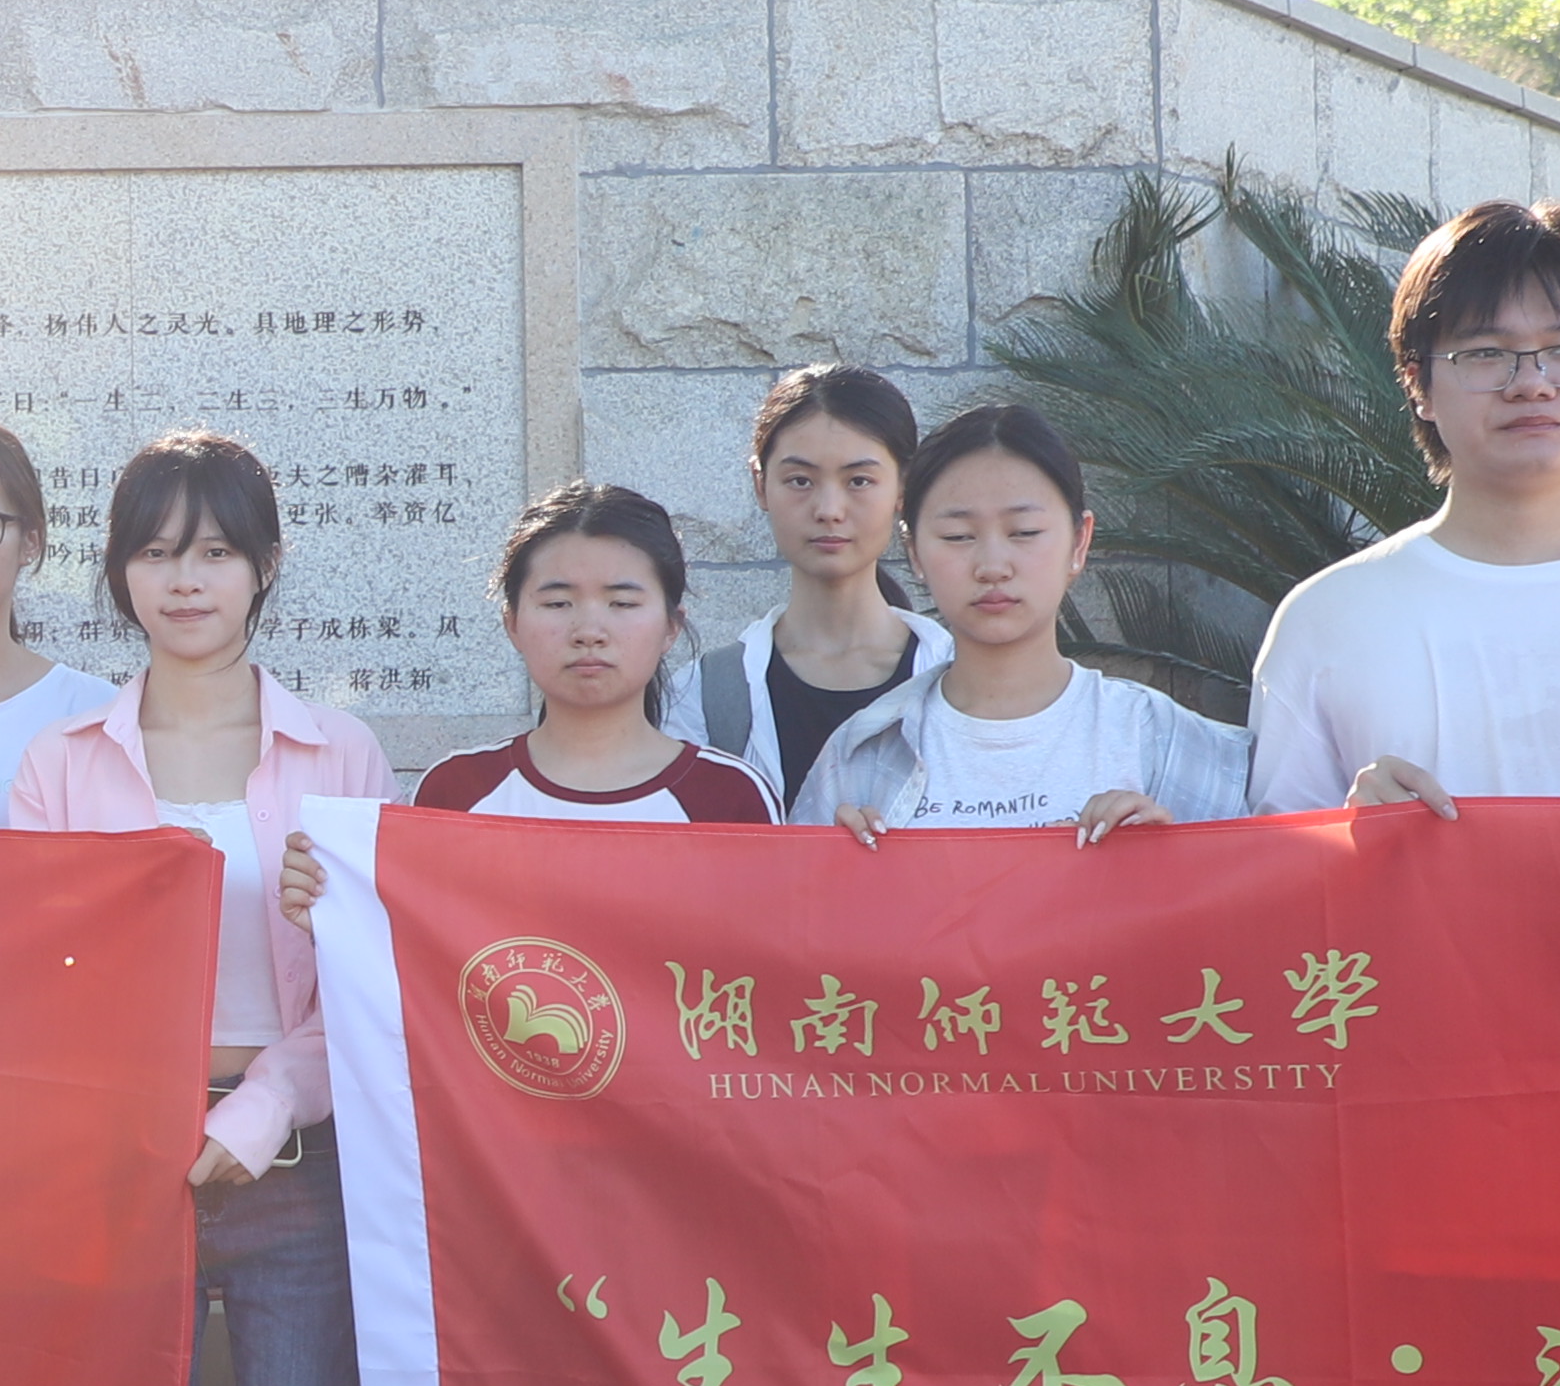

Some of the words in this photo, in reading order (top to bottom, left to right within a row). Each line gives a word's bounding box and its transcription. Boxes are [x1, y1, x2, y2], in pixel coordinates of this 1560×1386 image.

[350, 667, 433, 692] 蒋洪新
[914, 795, 943, 819] BE
[952, 793, 1049, 819] ROMANTIC
[708, 1073, 857, 1101] HUNAN
[867, 1071, 1052, 1098] NORMAL
